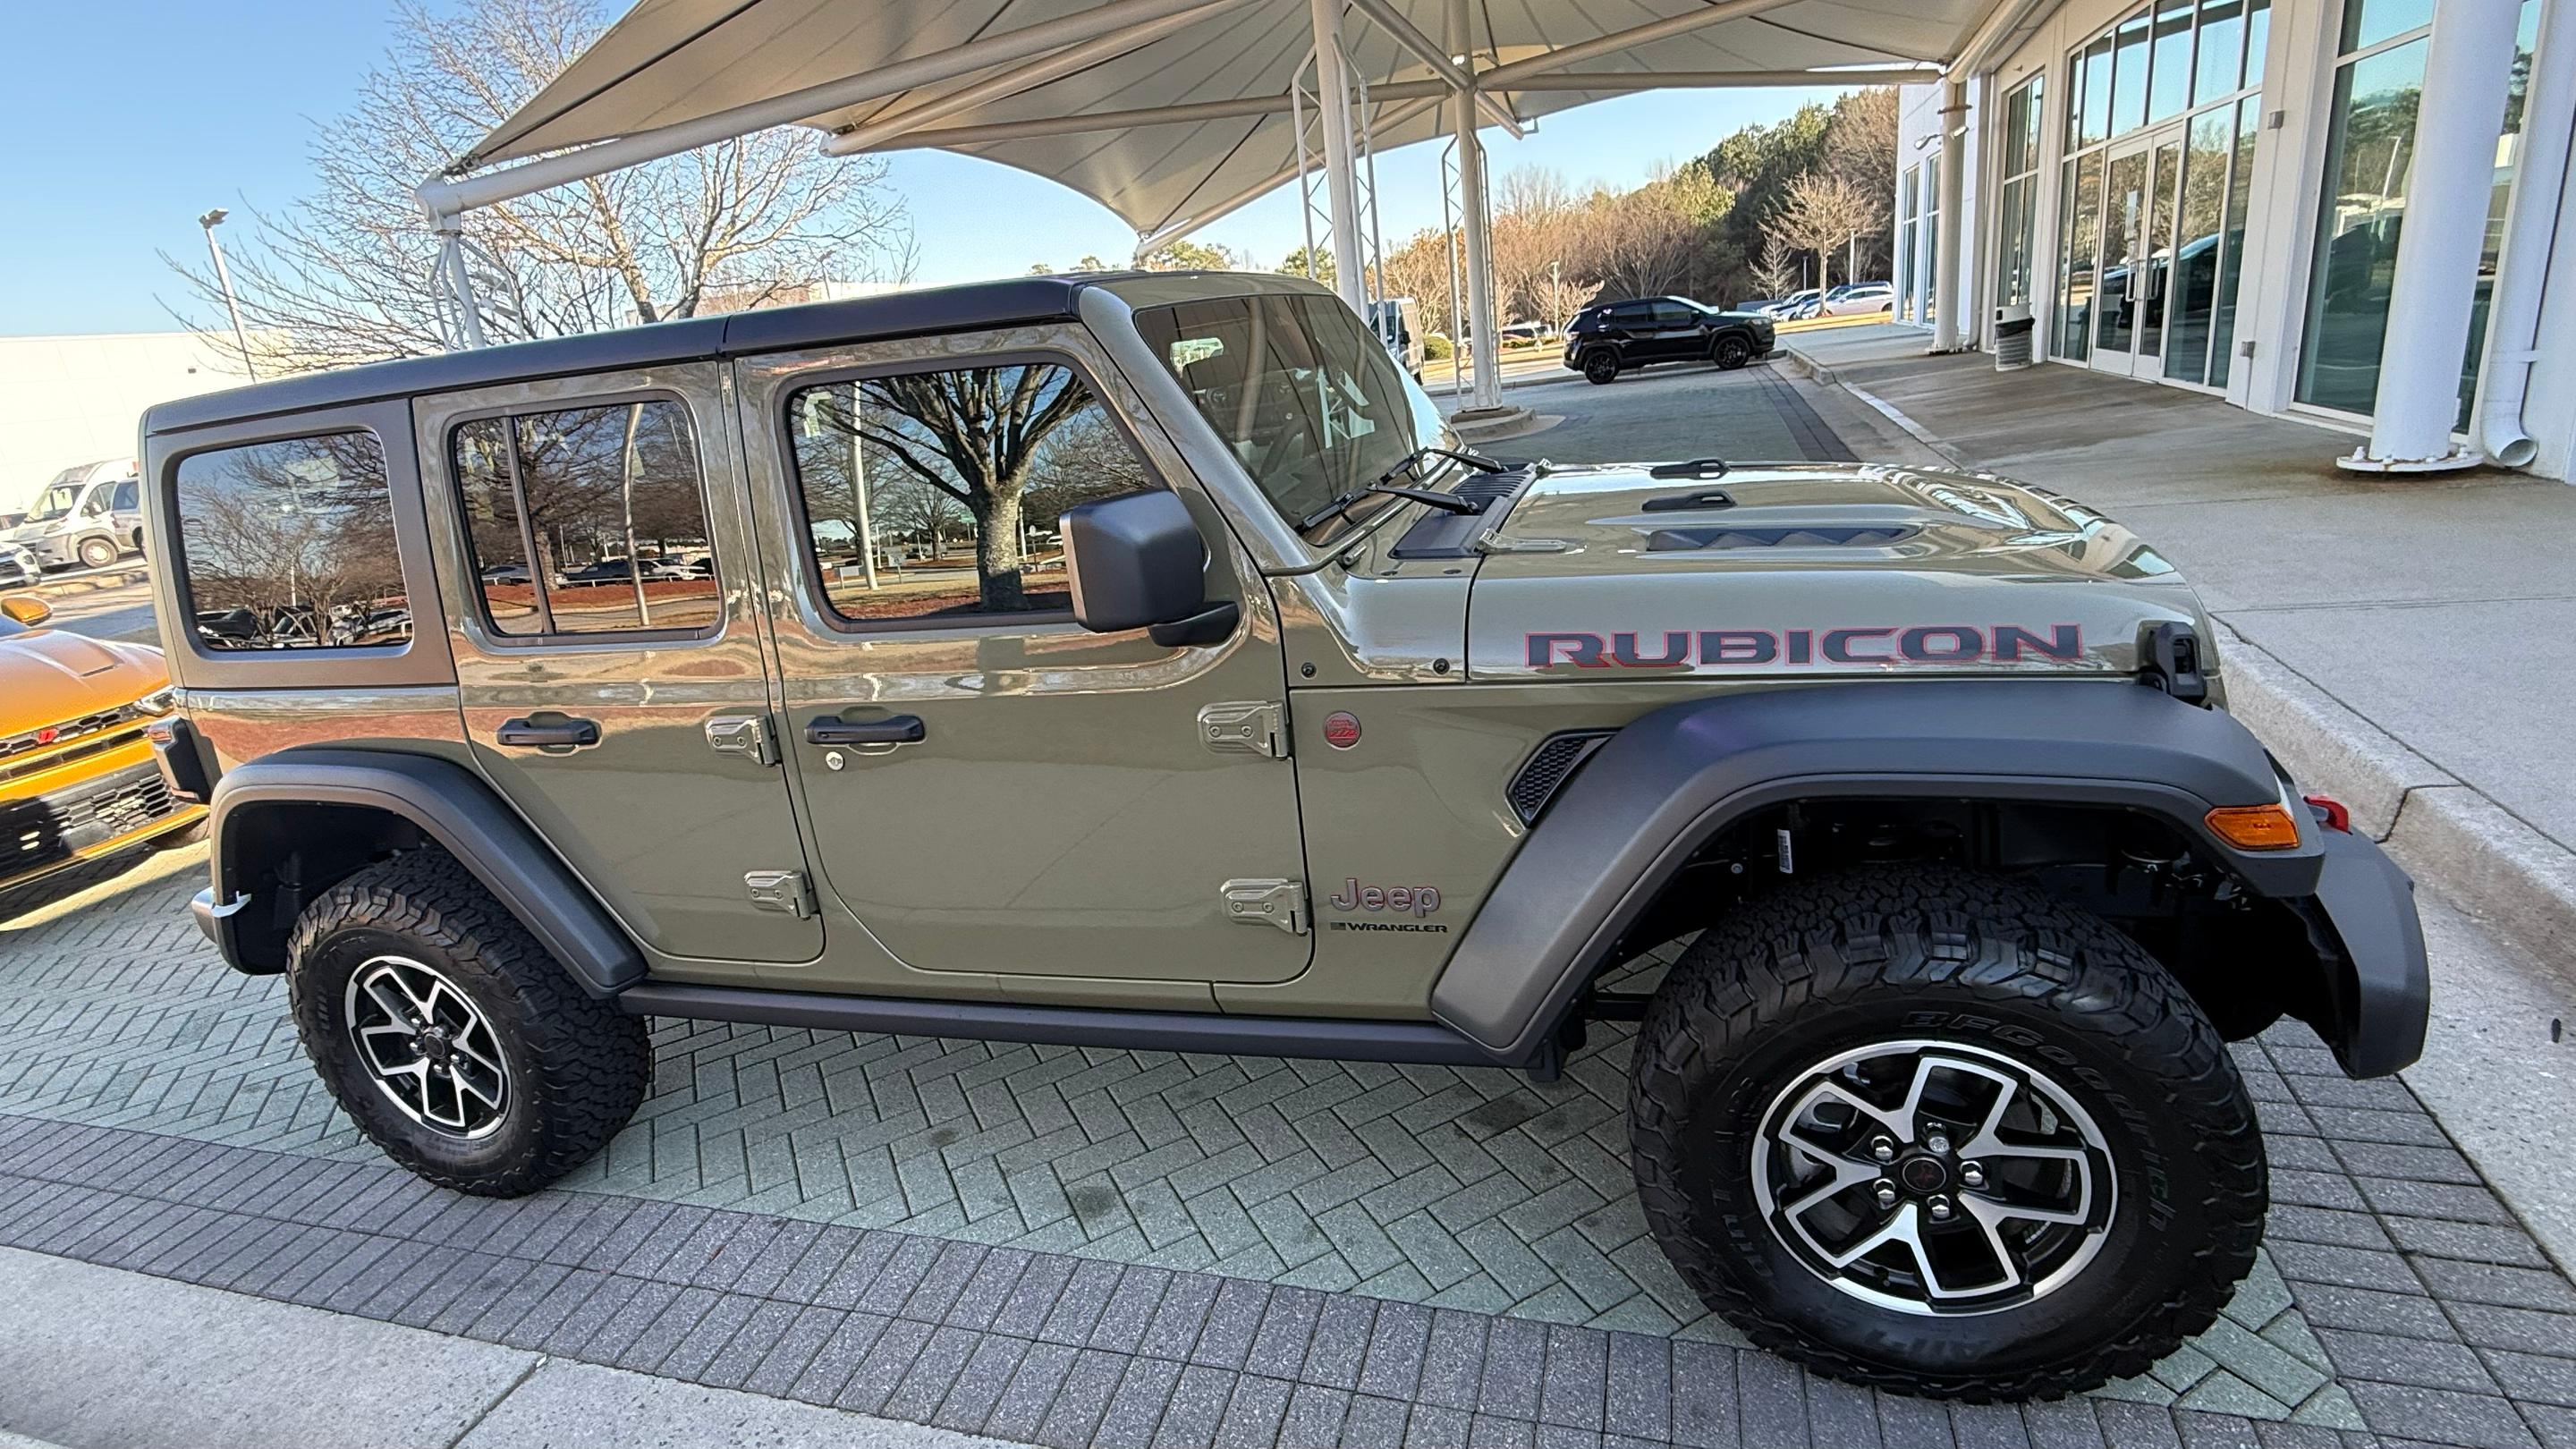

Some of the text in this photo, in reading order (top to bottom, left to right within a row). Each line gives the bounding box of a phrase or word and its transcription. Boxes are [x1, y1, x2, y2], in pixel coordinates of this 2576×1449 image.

[1525, 623, 2083, 668] RUBICON
[1330, 877, 1441, 918] Jeep
[1346, 922, 1448, 933] WRANGLER
